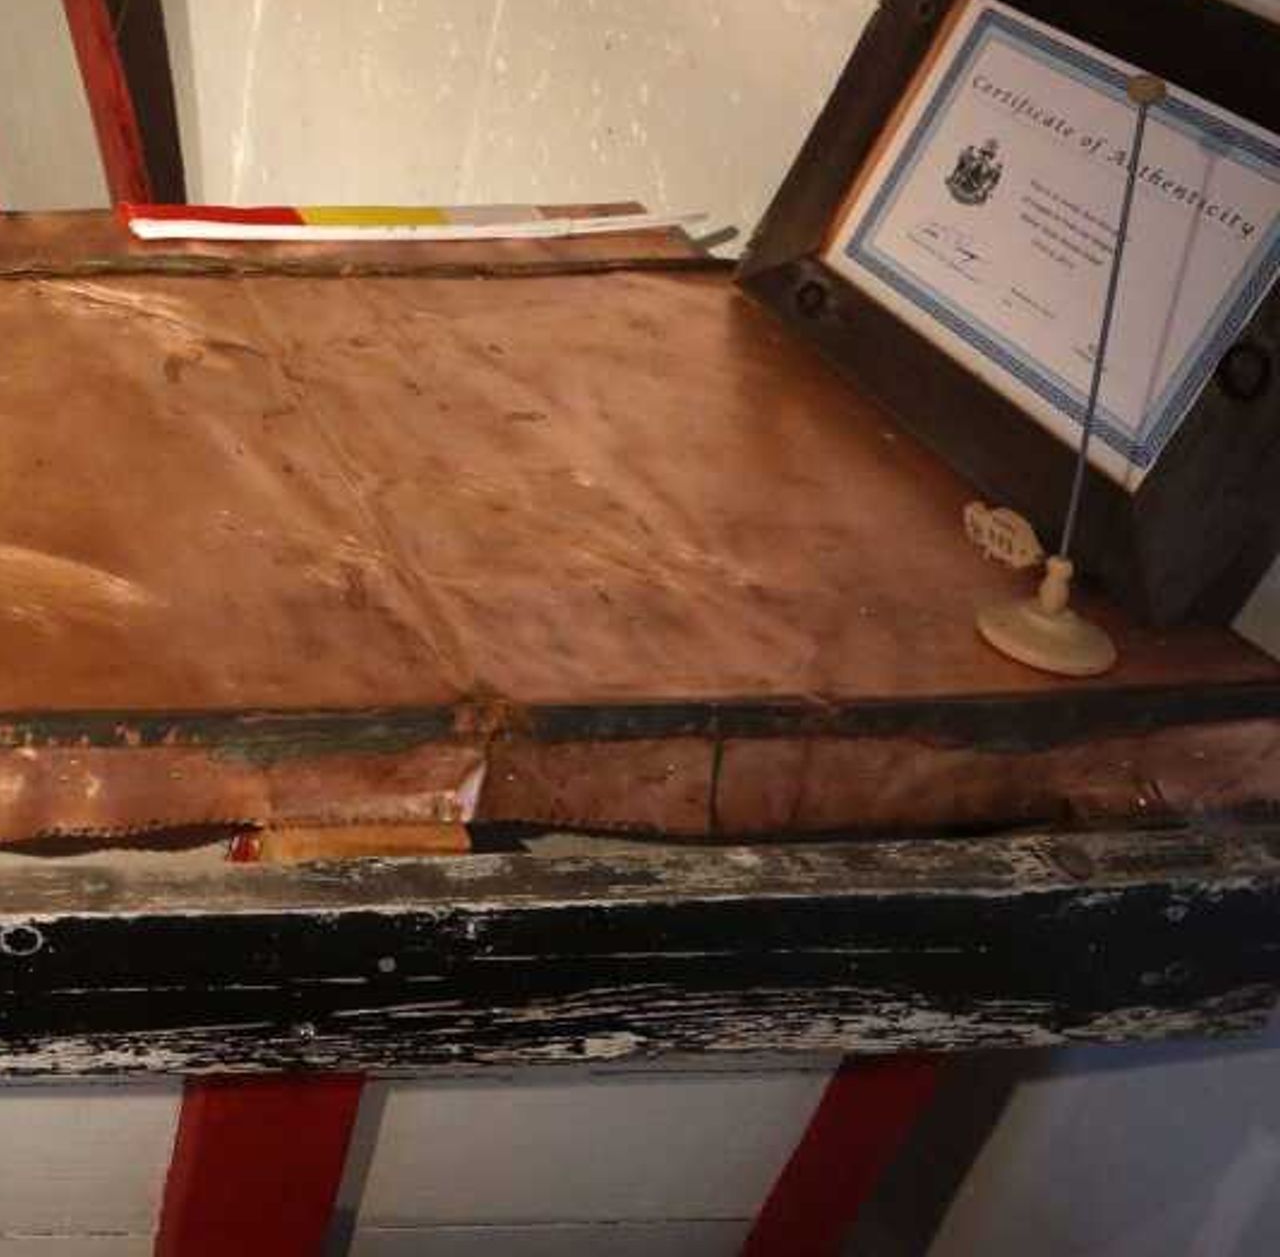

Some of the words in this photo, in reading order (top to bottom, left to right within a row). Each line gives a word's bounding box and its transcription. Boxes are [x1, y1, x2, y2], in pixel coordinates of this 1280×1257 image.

[972, 75, 1075, 139] Certificate
[1080, 133, 1108, 155] of
[1107, 148, 1257, 237] Athenticity
